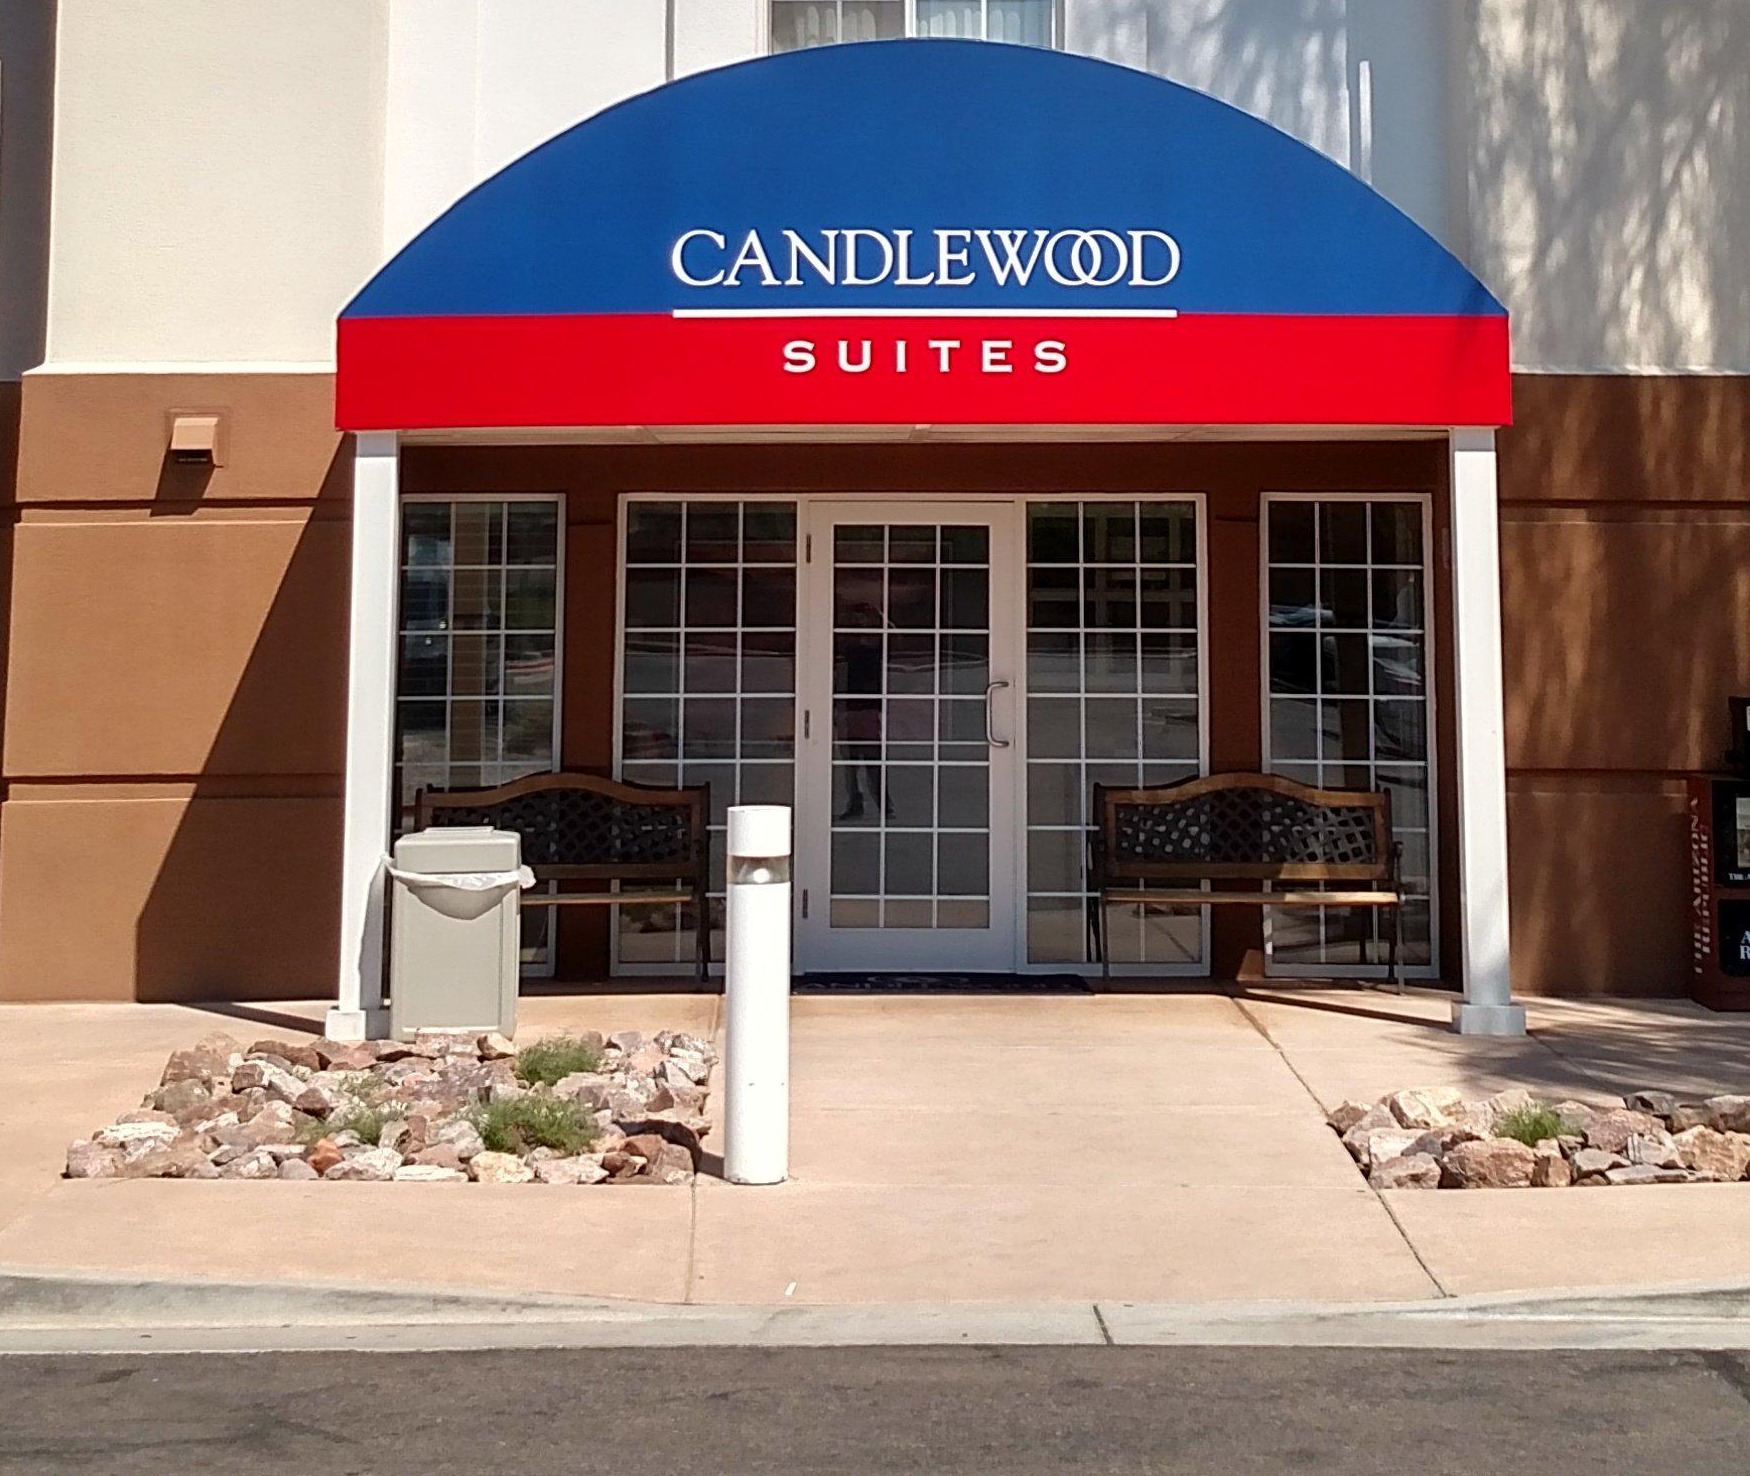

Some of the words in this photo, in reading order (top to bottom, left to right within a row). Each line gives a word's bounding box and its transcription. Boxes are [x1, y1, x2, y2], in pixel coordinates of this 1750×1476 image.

[671, 228, 1181, 287] CANDLEWOOD
[782, 339, 1068, 373] SUITES
[1728, 872, 1744, 881] THE
